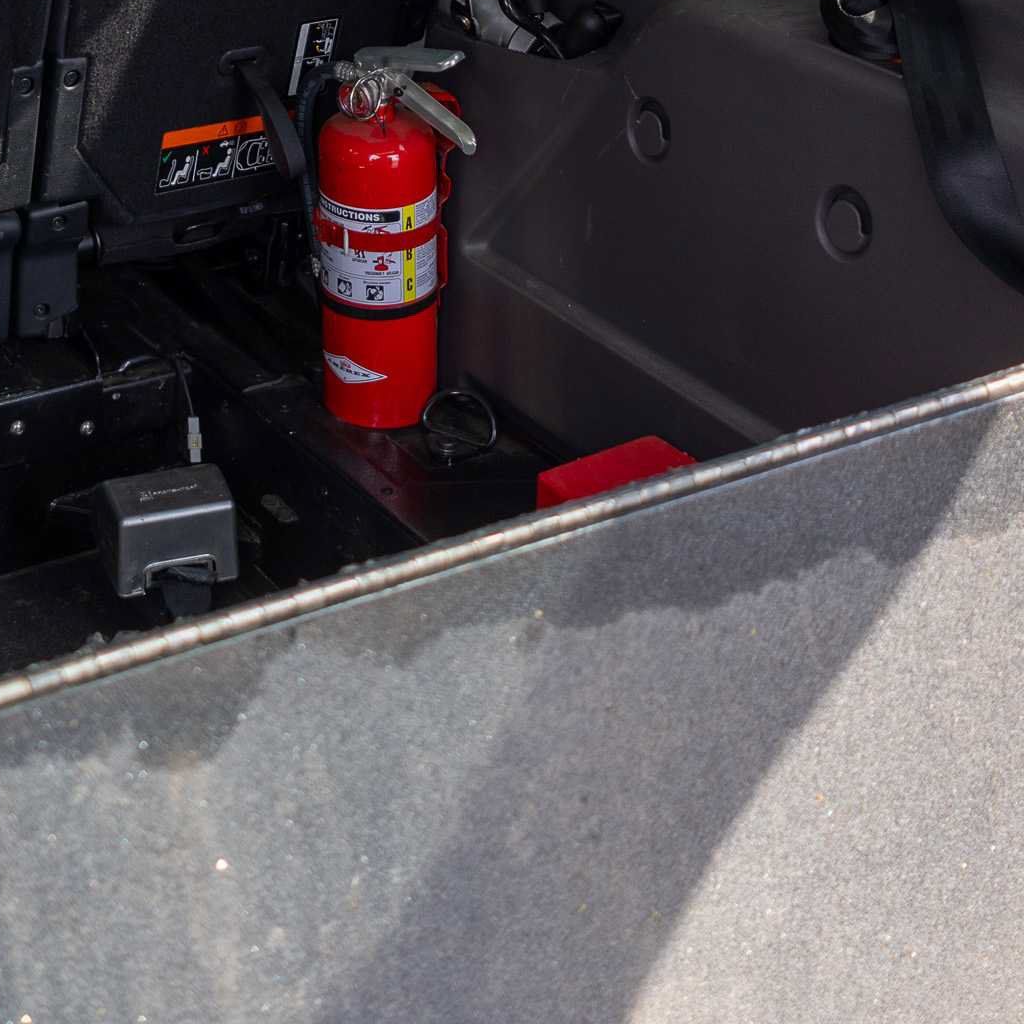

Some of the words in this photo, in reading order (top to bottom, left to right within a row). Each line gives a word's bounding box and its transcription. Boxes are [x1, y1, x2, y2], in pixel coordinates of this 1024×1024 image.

[405, 217, 413, 230] A
[406, 249, 413, 261] B
[406, 278, 413, 292] C
